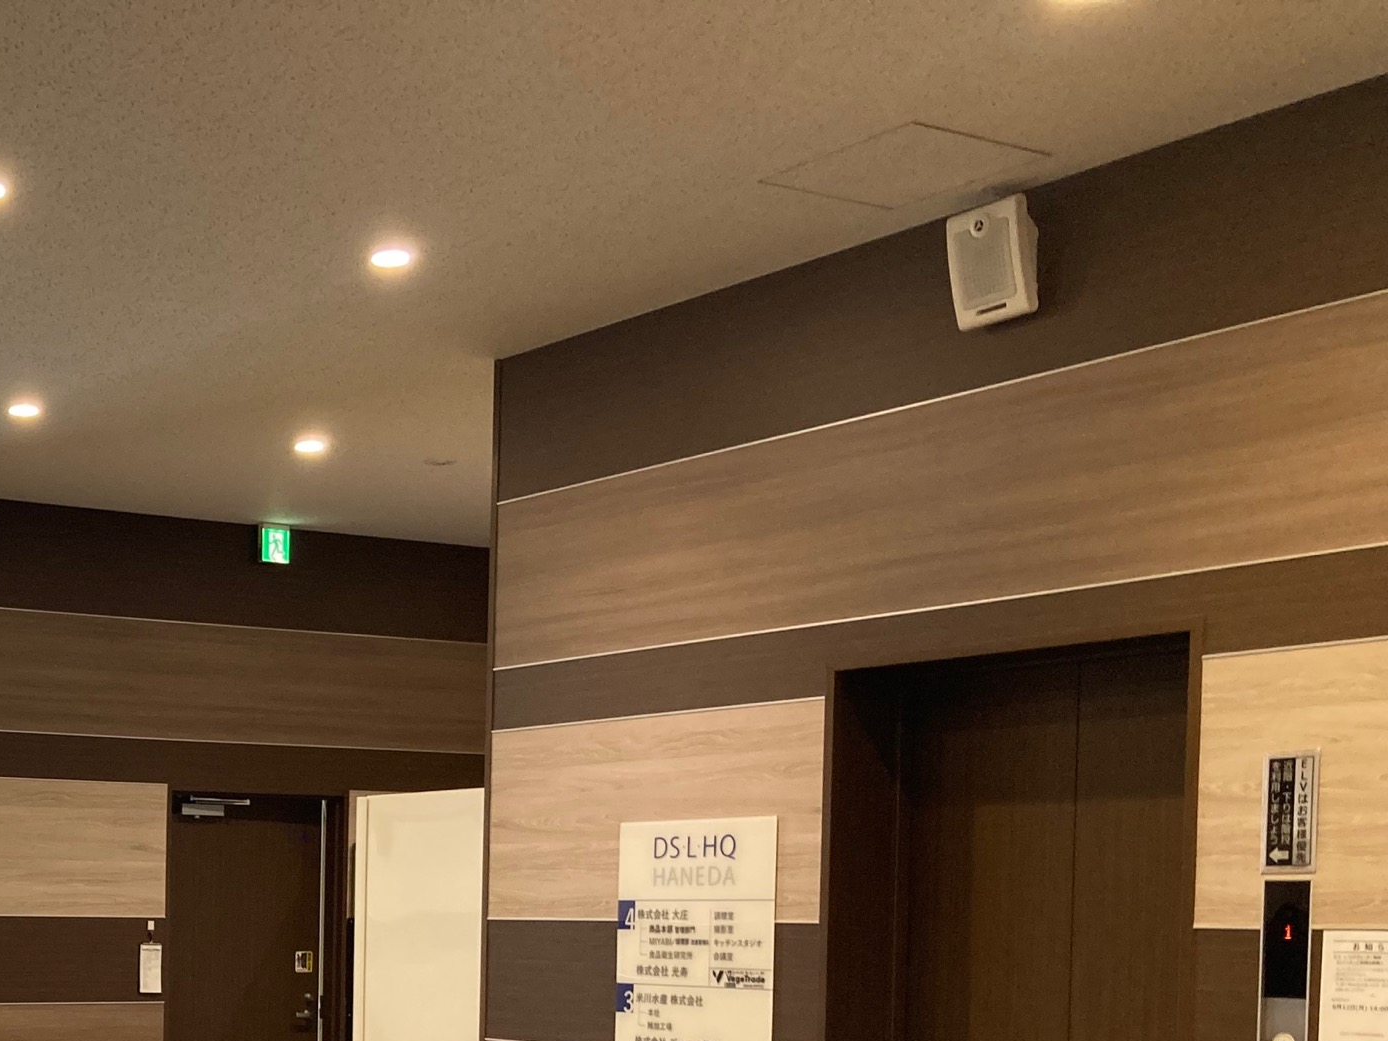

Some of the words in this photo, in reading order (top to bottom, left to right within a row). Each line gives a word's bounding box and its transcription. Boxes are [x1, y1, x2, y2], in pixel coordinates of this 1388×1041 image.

[653, 866, 736, 887] HANEDA
[625, 907, 635, 930] 4
[637, 909, 670, 921] 株式会社
[672, 909, 689, 921] 大庄
[1284, 924, 1292, 940] 1
[714, 939, 763, 948] キッチンスタジオ
[636, 965, 669, 978] 株式会社
[623, 990, 634, 1013] 3
[670, 994, 703, 1008] 株式会社
